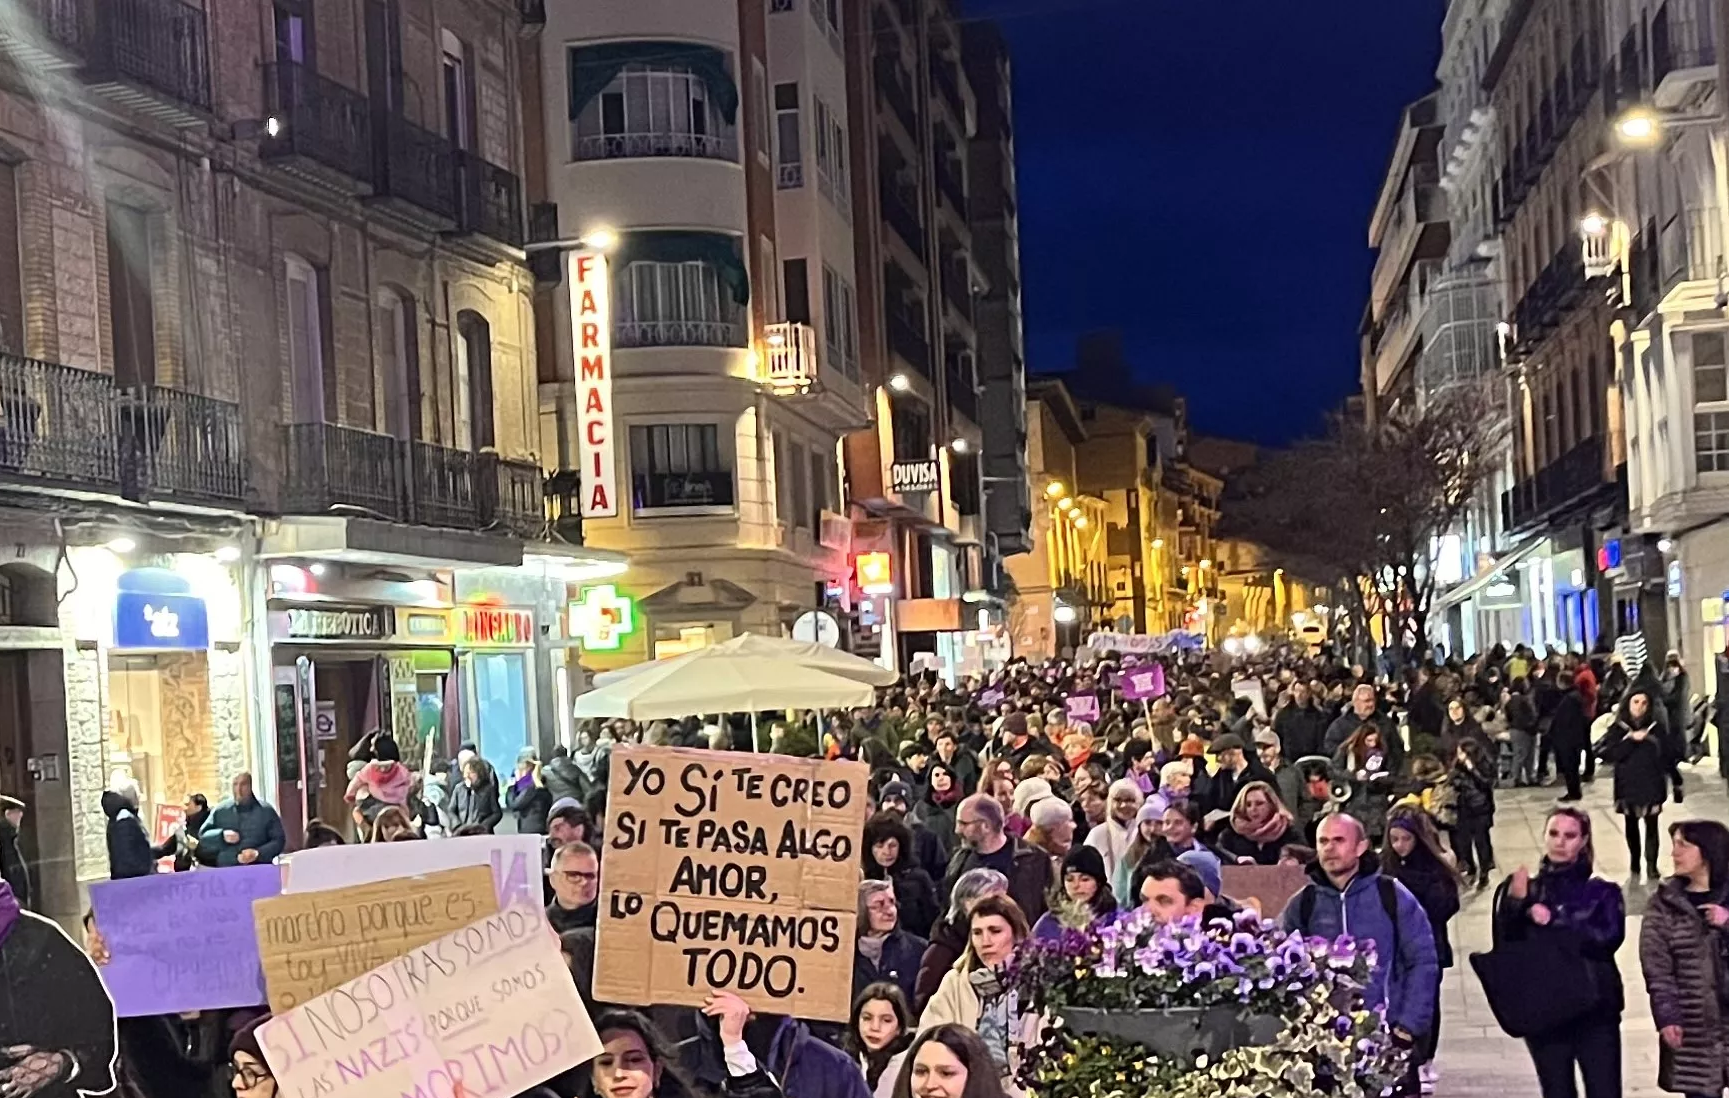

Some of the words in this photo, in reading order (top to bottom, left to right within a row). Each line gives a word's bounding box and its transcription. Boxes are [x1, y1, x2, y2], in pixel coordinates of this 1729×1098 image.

[574, 255, 610, 512] FARMACIA
[892, 461, 938, 485] DUVISA
[623, 759, 666, 796] YO
[731, 767, 764, 800] TE
[770, 773, 851, 809] CREO
[611, 811, 645, 850] SI
[659, 819, 690, 848] TE
[696, 820, 768, 856] PASA
[776, 820, 852, 862] ALGO
[669, 855, 778, 904] AMOR,
[265, 902, 346, 946] marcho
[358, 892, 434, 938] porque
[610, 889, 643, 919] LO
[650, 900, 840, 953] QUEMAMOS
[262, 1010, 315, 1076] SI
[304, 936, 458, 1051] NOSOTRAS
[453, 905, 543, 966] SOMOS
[285, 953, 329, 984] toy
[490, 965, 547, 1004] SOMOS
[682, 948, 806, 998] TODO.
